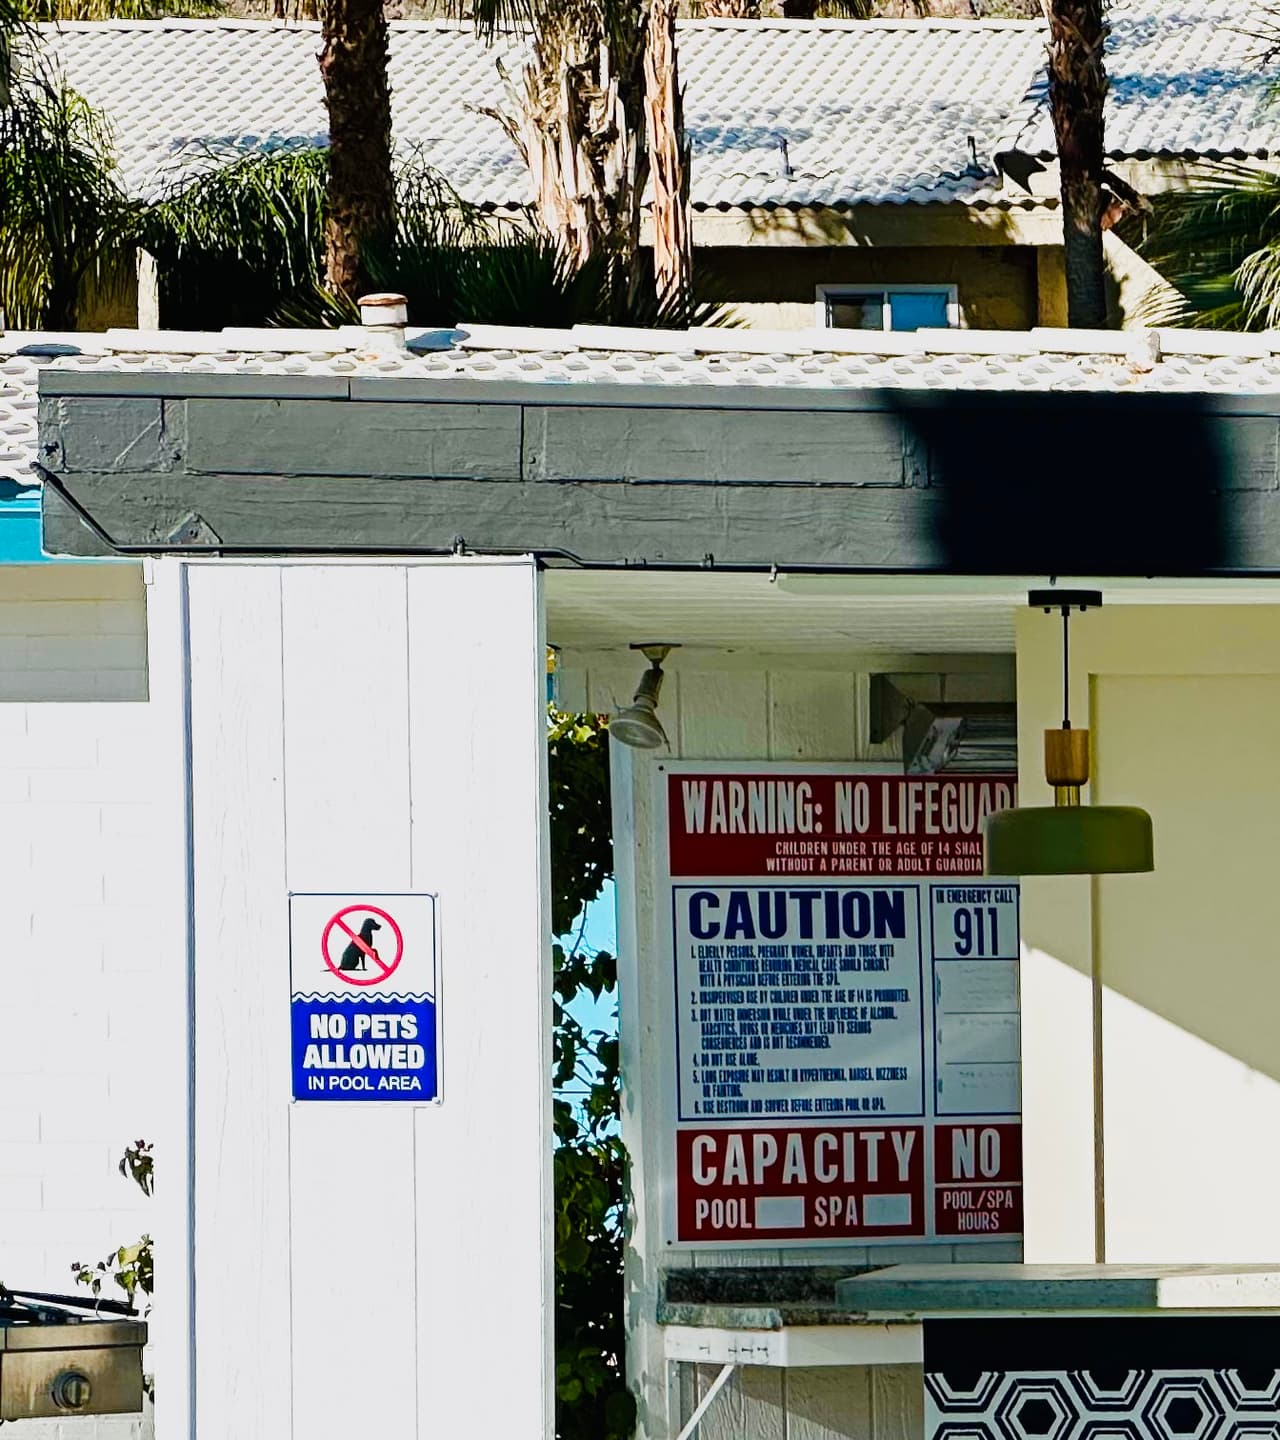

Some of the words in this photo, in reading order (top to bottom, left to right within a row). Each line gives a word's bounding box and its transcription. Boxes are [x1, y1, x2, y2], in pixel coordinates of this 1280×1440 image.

[681, 780, 823, 834] WARNING:
[835, 781, 869, 834] NO
[882, 782, 1018, 834] LIFEGUAR
[776, 841, 828, 855] CHILDREN
[832, 841, 866, 855] UNDER
[872, 841, 891, 855] THE
[896, 841, 914, 855] AGE
[921, 841, 934, 855] OF
[938, 841, 950, 855] 14
[955, 841, 982, 855] SHAL
[766, 858, 815, 872] WITHOUT
[820, 858, 827, 872] A
[831, 857, 873, 871] PARENT
[878, 857, 892, 871] OR
[897, 857, 931, 871] ADULT
[936, 857, 982, 871] GUARDIA
[936, 889, 945, 904] IN
[947, 889, 991, 904] EMERGENCY
[995, 888, 1014, 903] CALL
[688, 890, 906, 940] CAUTION
[954, 907, 998, 956] 911
[310, 1014, 346, 1039] NO
[354, 1014, 418, 1039] PETS
[302, 1044, 425, 1070] ALLOWED
[308, 1076, 324, 1090] IN
[329, 1075, 374, 1090] POOL
[378, 1075, 422, 1090] AREA
[691, 1130, 917, 1186] CAPACITY
[951, 1127, 1001, 1180] NO
[943, 1189, 1014, 1210] POOL/SPA
[695, 1198, 753, 1230] POOL
[814, 1195, 858, 1227] SPA
[958, 1211, 1000, 1231] HOURS
